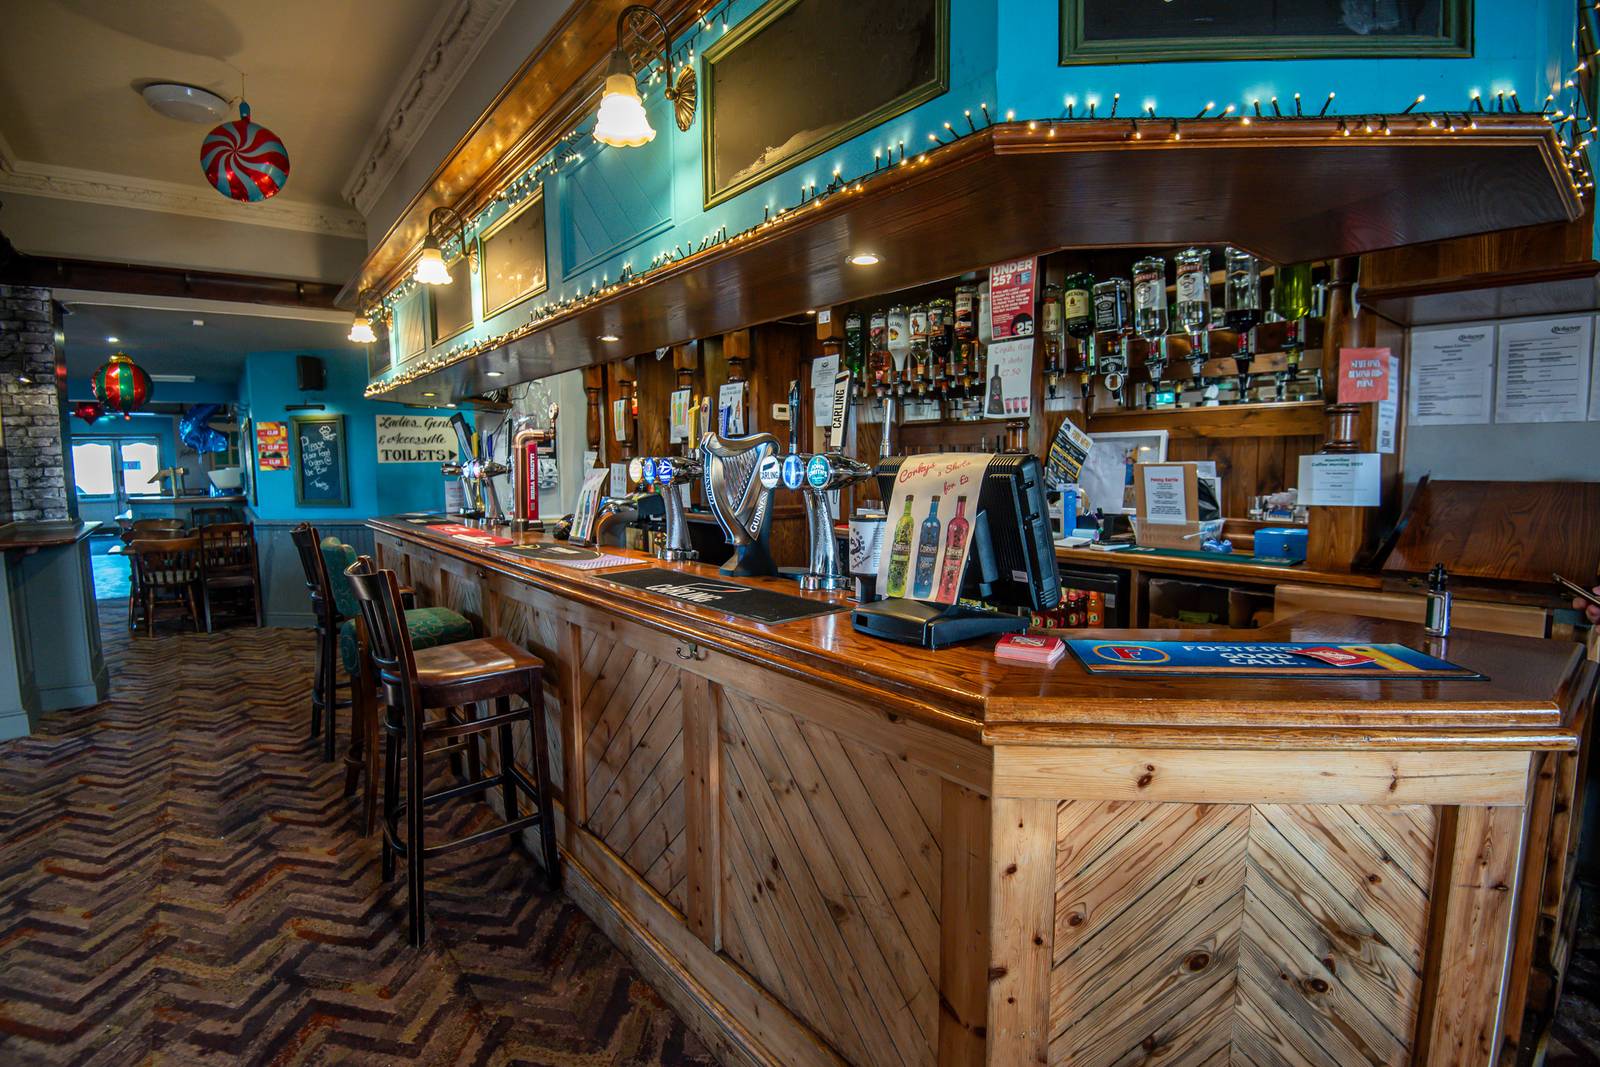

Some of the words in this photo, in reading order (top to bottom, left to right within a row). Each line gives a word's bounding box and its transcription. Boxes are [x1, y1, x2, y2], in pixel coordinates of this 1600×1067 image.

[993, 259, 1032, 275] UNDER
[992, 274, 1012, 287] 25?
[833, 389, 845, 429] CARLING
[387, 432, 446, 444] Accessible
[380, 449, 446, 460] TOILETS
[944, 480, 956, 496] for
[750, 490, 768, 533] GUINNESS
